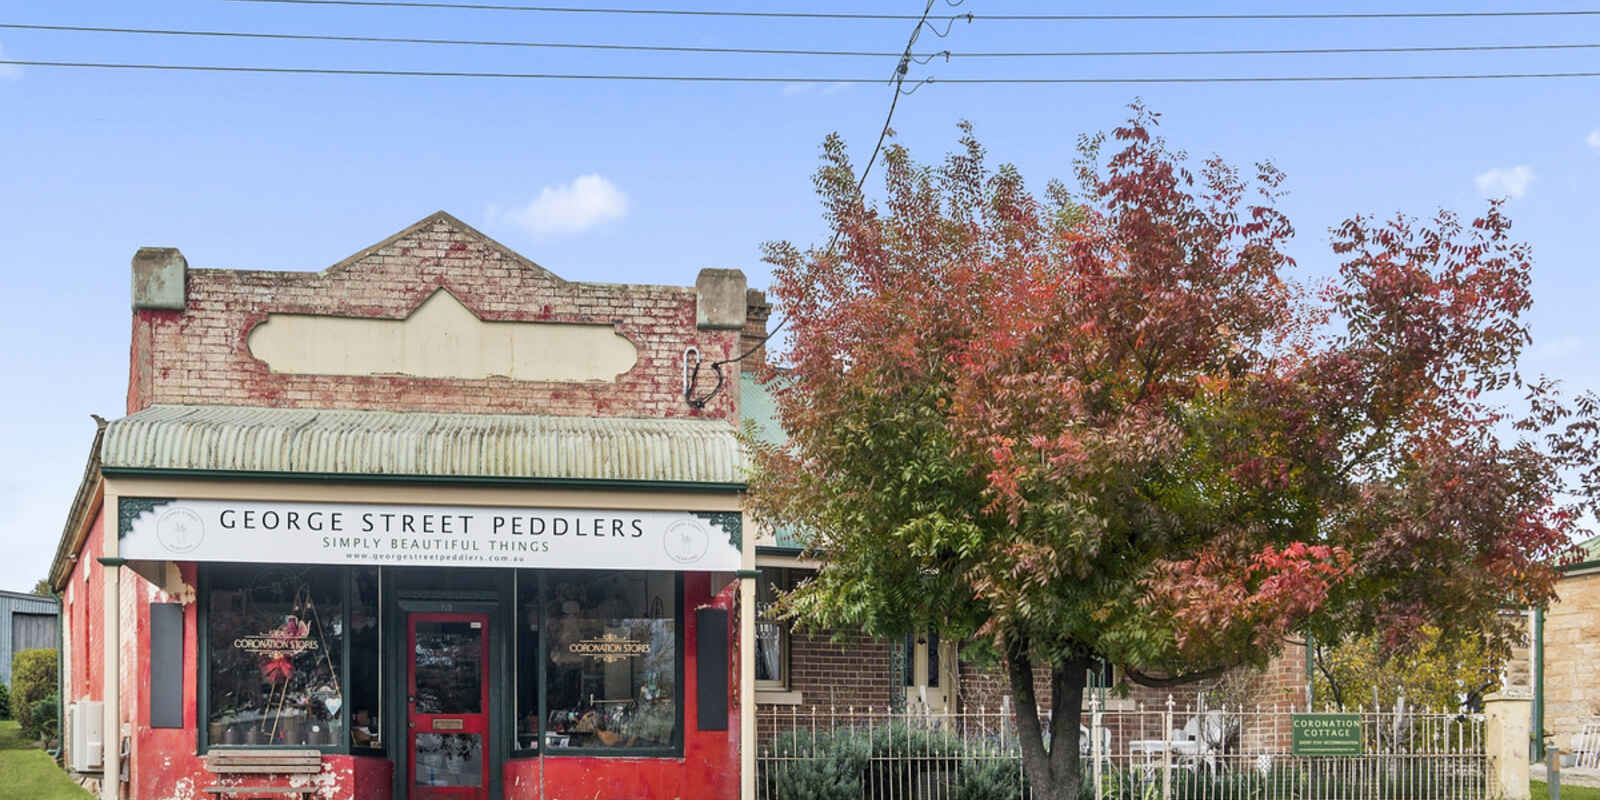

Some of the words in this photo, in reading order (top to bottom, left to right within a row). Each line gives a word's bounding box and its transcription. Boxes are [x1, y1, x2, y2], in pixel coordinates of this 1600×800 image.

[220, 510, 343, 531] GEORGE
[362, 513, 474, 533] STREET
[493, 516, 643, 538] PEDDLERS
[323, 536, 381, 549] SIMPLY
[391, 538, 480, 551] BEAUTIFUL
[489, 540, 550, 552] THINGS
[346, 552, 525, 562] www.georgestreetpeddlers.com.au
[233, 639, 289, 649] CORONATION
[290, 639, 319, 649] STORES
[569, 643, 622, 653] CORONATION
[623, 643, 650, 653] STORES
[1294, 719, 1360, 728] CORONATION
[1303, 729, 1351, 737] COTTAGE
